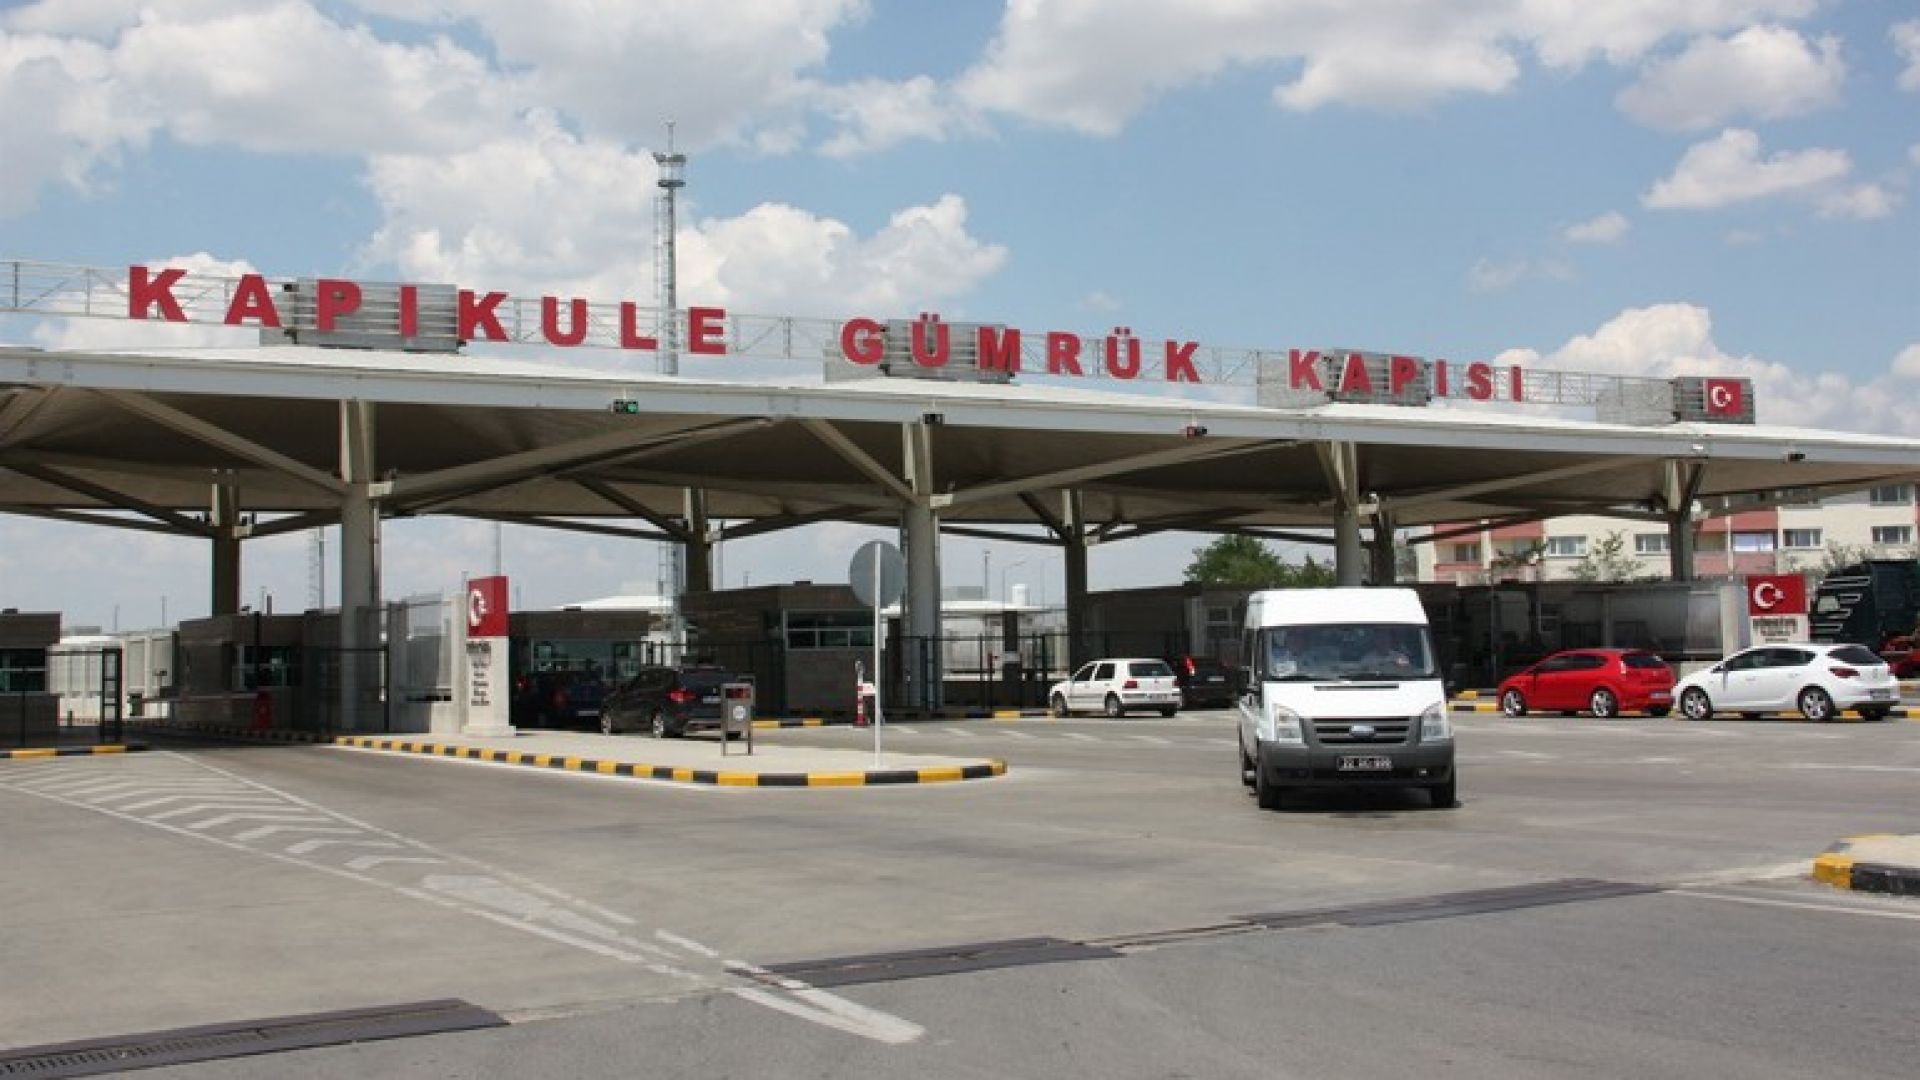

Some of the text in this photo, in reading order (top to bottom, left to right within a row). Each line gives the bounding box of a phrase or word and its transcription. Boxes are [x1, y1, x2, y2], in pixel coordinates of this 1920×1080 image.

[129, 265, 1524, 402] KAPIKULE GÜMRÜK KAPISI
